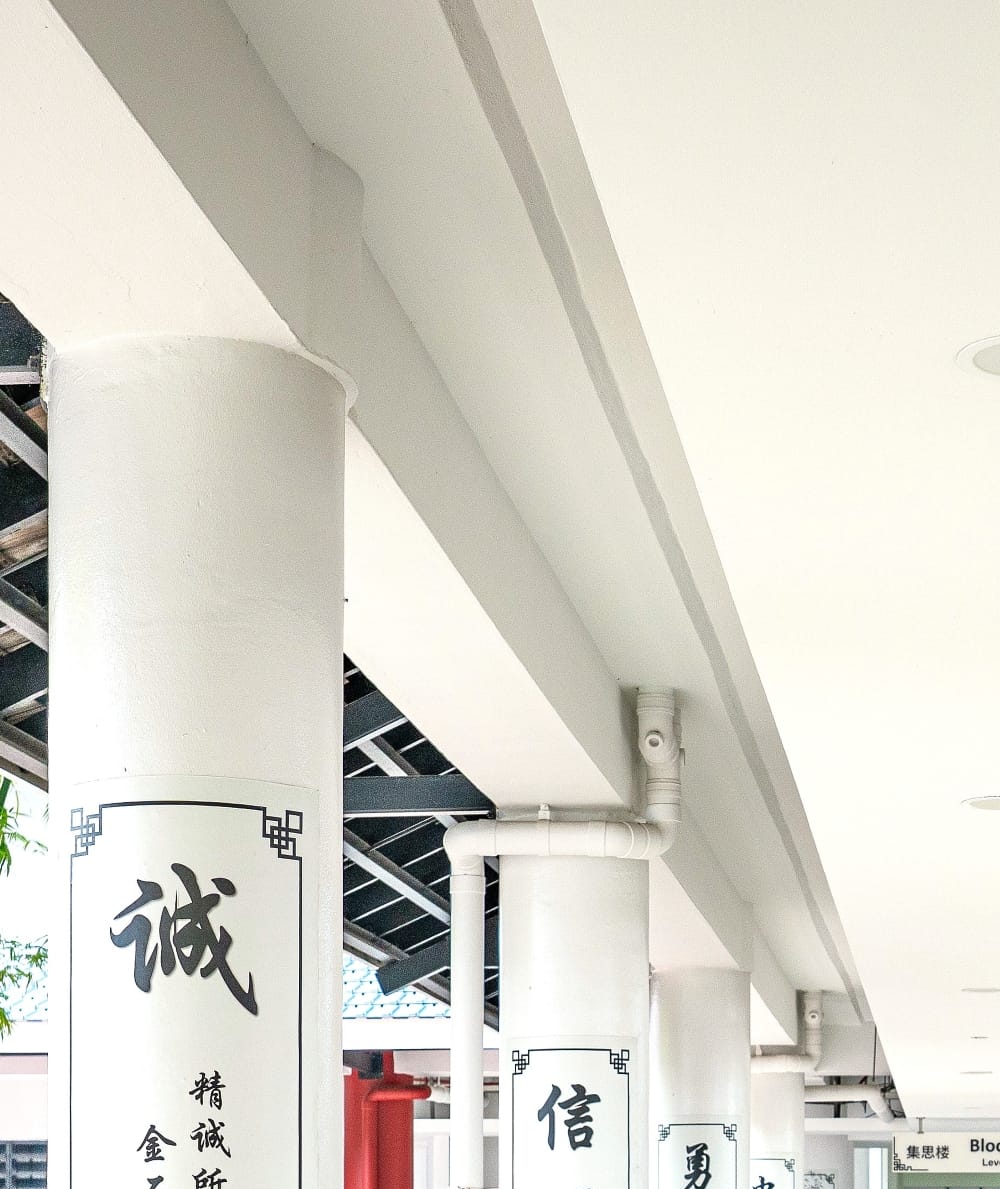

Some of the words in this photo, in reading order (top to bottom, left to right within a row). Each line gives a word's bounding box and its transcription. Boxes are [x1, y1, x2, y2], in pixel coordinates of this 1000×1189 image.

[537, 1084, 602, 1151] 信
[906, 1145, 949, 1160] 集思楼
